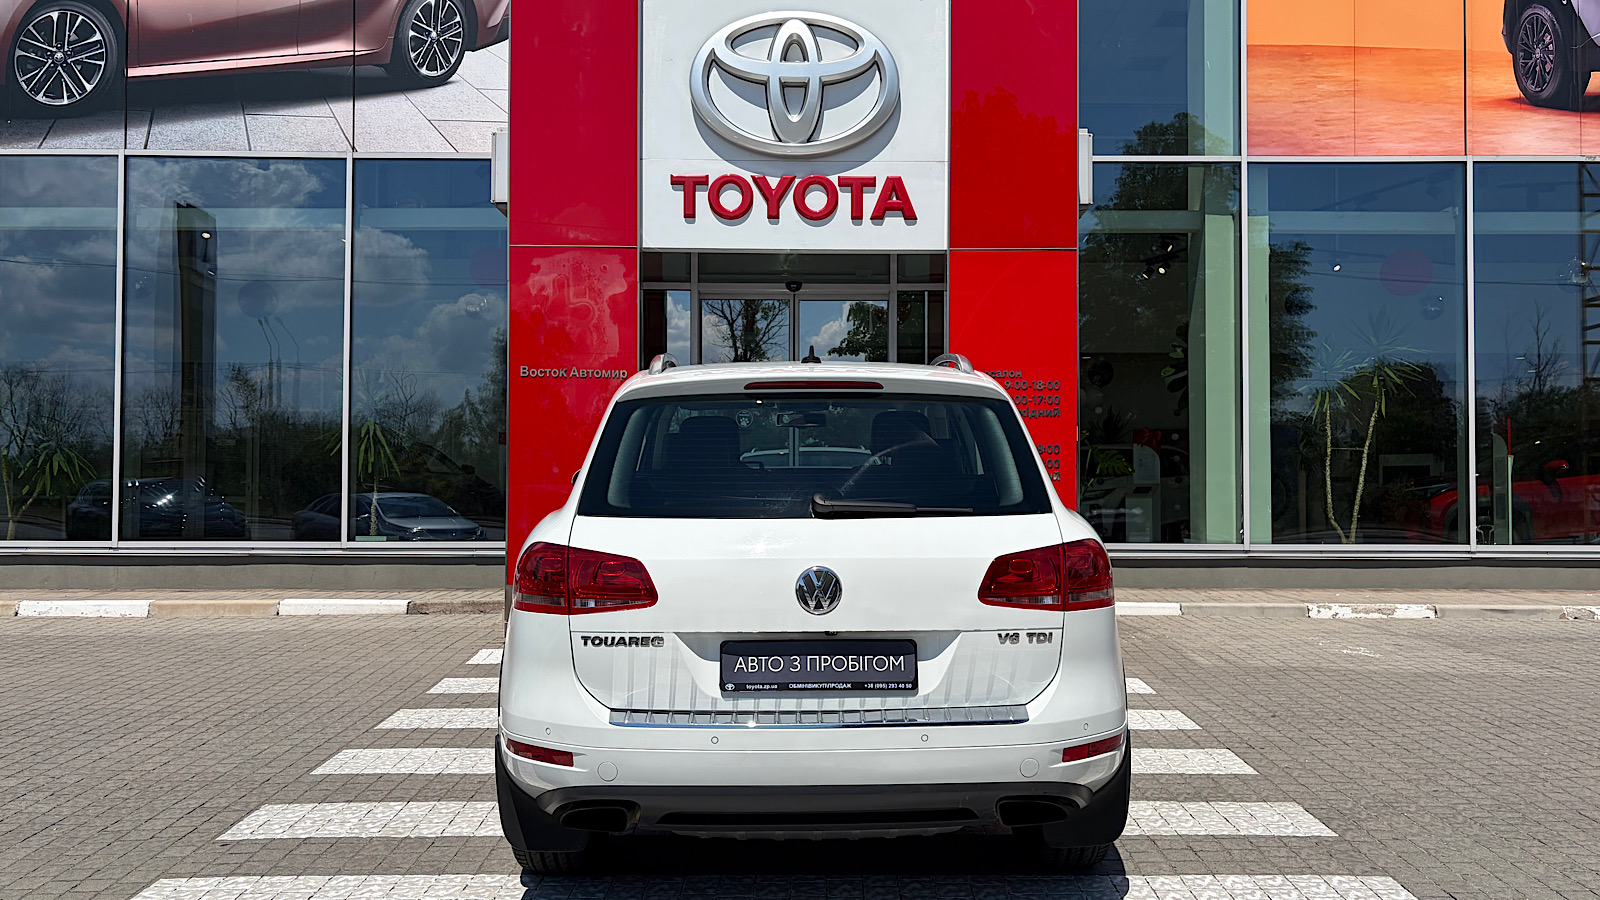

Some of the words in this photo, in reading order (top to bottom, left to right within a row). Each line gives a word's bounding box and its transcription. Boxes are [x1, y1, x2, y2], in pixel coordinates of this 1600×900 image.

[670, 173, 918, 221] TOYOTA
[520, 365, 567, 379] Восток
[570, 366, 629, 382] Автомир
[1013, 395, 1061, 405] 00-17:00
[1037, 444, 1061, 455] 8:00
[580, 635, 665, 648] TOUAREG
[997, 632, 1021, 645] V6
[1025, 631, 1053, 645] TDI
[734, 656, 784, 673] АВТО
[806, 655, 905, 672] ПРОБІГОМ
[745, 683, 778, 691] toyota.zp.ua
